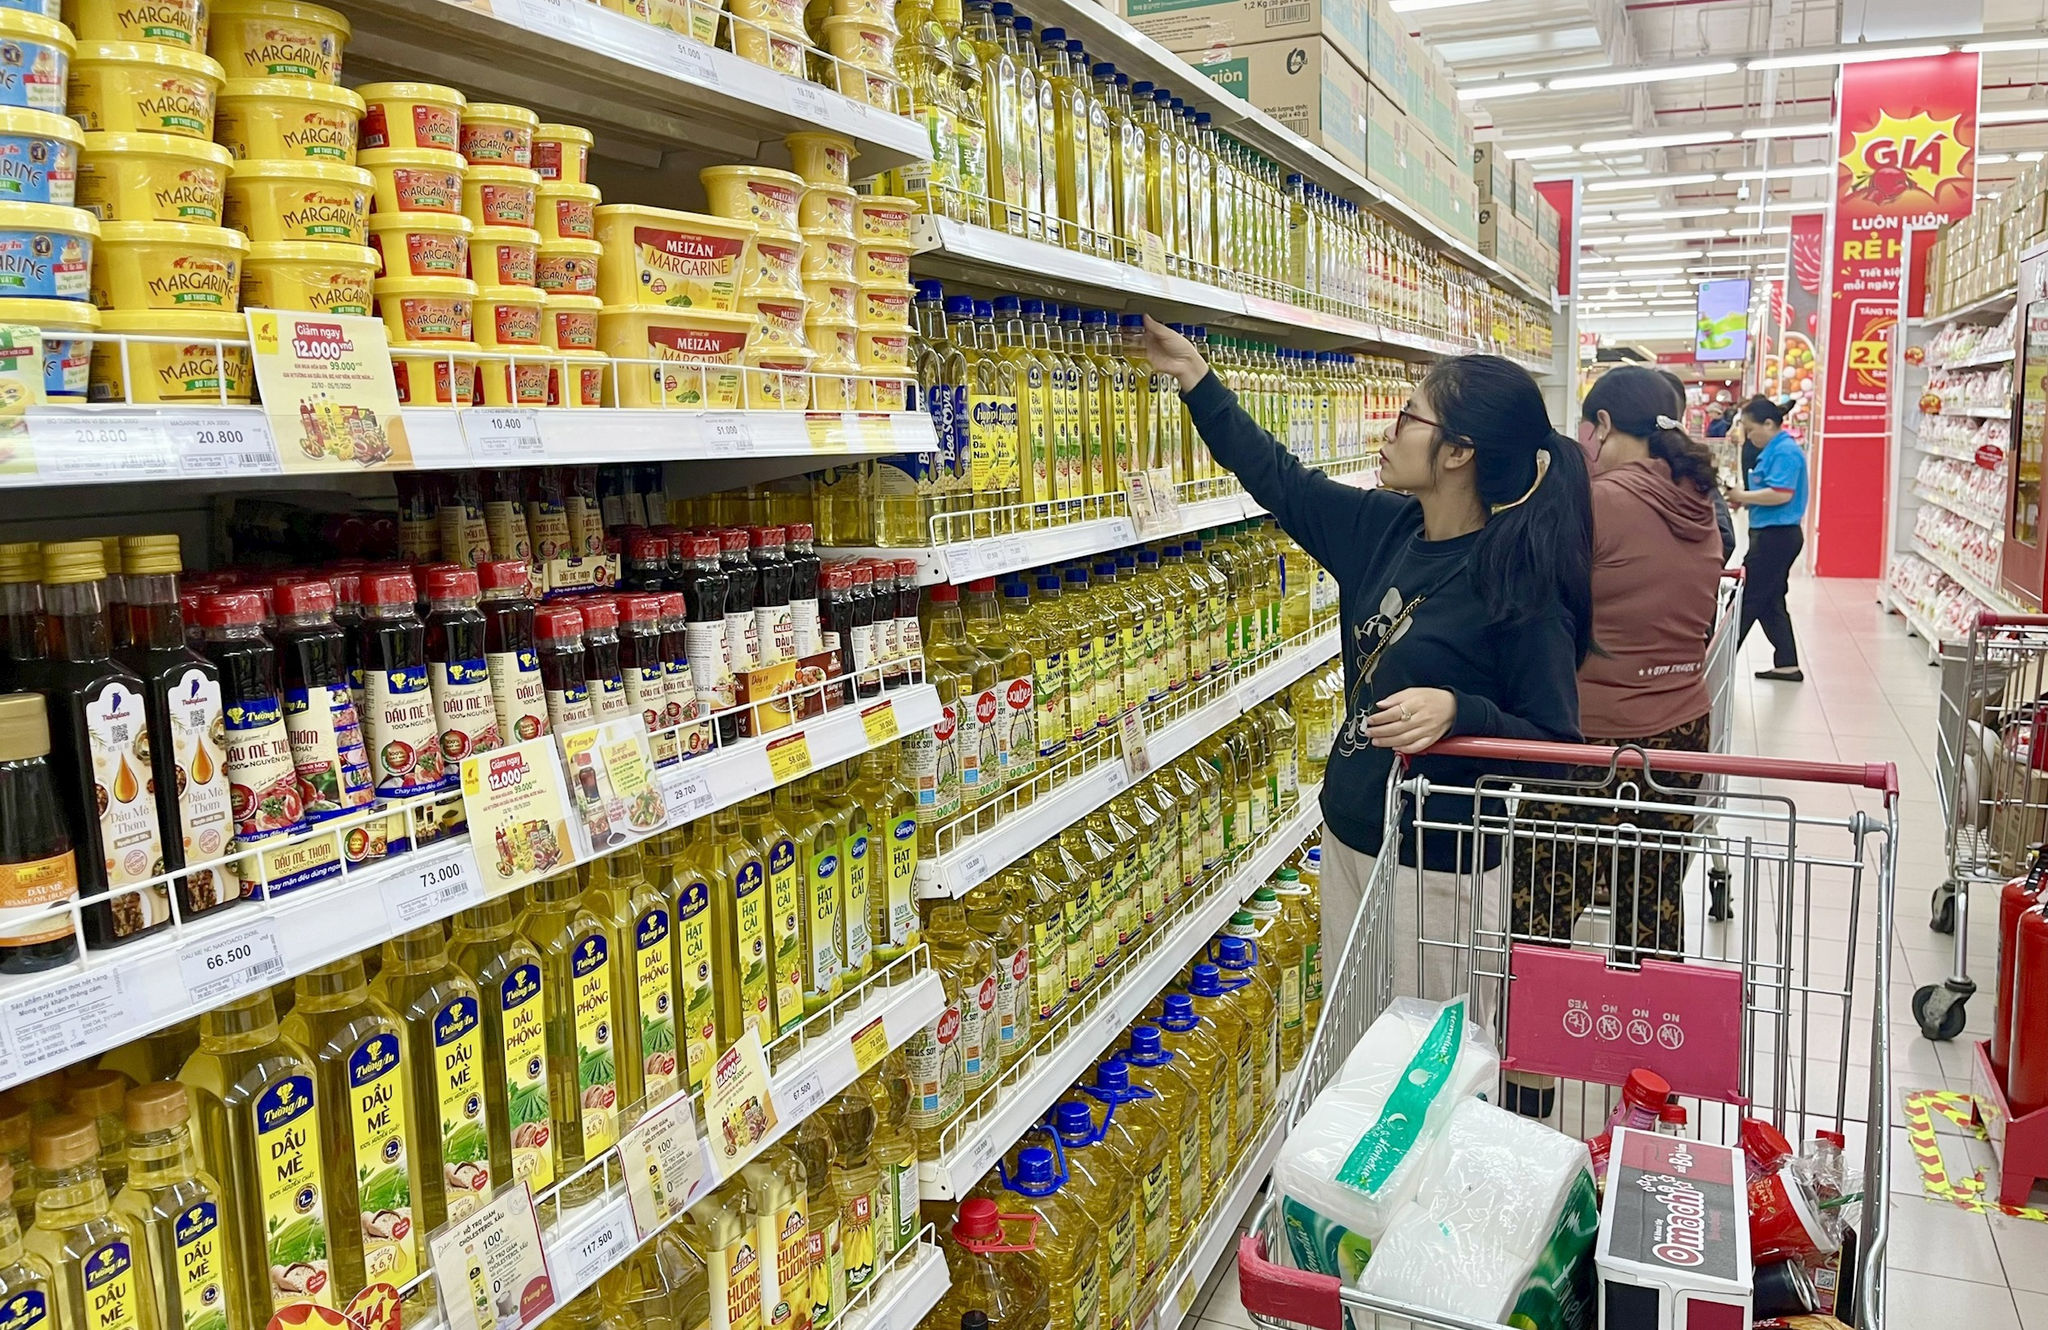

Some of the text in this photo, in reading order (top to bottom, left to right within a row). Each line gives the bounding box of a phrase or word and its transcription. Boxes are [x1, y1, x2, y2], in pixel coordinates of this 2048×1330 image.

[244, 45, 330, 75] MARGARINE
[461, 138, 512, 156] MARGARINE
[1863, 132, 1950, 176] GIÁ
[283, 206, 361, 233] MARGARINE
[1852, 212, 1949, 230] LUÔN LUÔN
[666, 240, 714, 257] MEIZAN
[1843, 232, 1882, 260] RẺ
[649, 251, 728, 276] MARGARINE
[1859, 267, 1901, 278] Tiết kiệ
[148, 272, 234, 300] MARGARINE
[1843, 280, 1896, 291] mỗi ngày
[407, 315, 461, 329] MARGARINE
[297, 325, 341, 339] Giảm ngay
[294, 340, 340, 358] 12.000
[677, 338, 720, 352] MEIZAN
[159, 358, 247, 384] MARGARINE
[330, 362, 356, 371] 99.000
[491, 419, 521, 429] 10.400
[717, 426, 737, 434] 51.000
[942, 389, 955, 460] BeeSoya
[76, 429, 127, 443] 20.800
[197, 430, 243, 444] 20.800
[444, 694, 483, 714] DẦU MÈ
[247, 708, 278, 721] Tường
[385, 704, 426, 724] DẦU MÈ
[250, 756, 282, 768] NGUYÊN
[491, 755, 522, 770] Giảm ngay
[489, 769, 521, 791] 12.000
[188, 786, 223, 803] Dầu Mè
[394, 785, 410, 796] Chay
[674, 784, 697, 800] 29.700
[110, 806, 150, 824] Dầu Mè
[192, 799, 220, 815] Thơm
[115, 820, 147, 835] Thơm
[896, 822, 916, 839] Simply
[274, 843, 331, 871] DẦU MÈ THƠM
[852, 839, 868, 857] Simply
[893, 848, 910, 865] HẠT
[420, 863, 460, 888] 73.000
[818, 857, 838, 876] Simply
[894, 861, 910, 879] CẢI
[776, 877, 791, 895] HẠT
[851, 868, 865, 885] HẠT
[777, 890, 791, 908] CẢI
[817, 887, 833, 904] HẠT
[852, 883, 865, 900] CẢI
[742, 899, 758, 918] HẠT
[818, 901, 833, 919] CẢI
[686, 921, 703, 943] HẠT
[744, 914, 758, 931] CẢI
[687, 935, 703, 957] CẢI
[206, 944, 252, 970] 66.500
[645, 948, 663, 970] DẦU
[640, 961, 669, 987] PHỘNG
[582, 975, 602, 998] DẦU
[576, 990, 609, 1018] PHỘNG
[1567, 999, 1589, 1010] YES
[1602, 1004, 1618, 1014] NO
[1632, 1009, 1649, 1018] NO
[512, 1006, 534, 1031] DẦU
[1663, 1013, 1680, 1022] NO
[506, 1022, 543, 1053] PHỘNG
[445, 1043, 473, 1071] DẦU
[356, 1058, 384, 1079] Tường
[450, 1063, 472, 1090] MÈ
[362, 1083, 393, 1113] DẦU
[793, 1082, 811, 1101] 67.500
[264, 1094, 310, 1125] Tường An
[367, 1105, 391, 1134] MÈ
[271, 1128, 306, 1160] DẦU
[277, 1154, 304, 1182] MÈ
[1669, 1152, 1692, 1169] Bò
[459, 1220, 494, 1247] CHOLESTEROL
[1652, 1183, 1704, 1267] Omachi
[581, 1230, 613, 1257] 117.500
[776, 1236, 809, 1267] HƯỚNG
[184, 1241, 212, 1266] DẦU
[489, 1249, 520, 1272] CHOLESTEROL
[189, 1259, 210, 1283] MÈ
[778, 1256, 810, 1287] DƯƠNG
[95, 1282, 126, 1311] DẦU
[100, 1301, 125, 1328] MÈ
